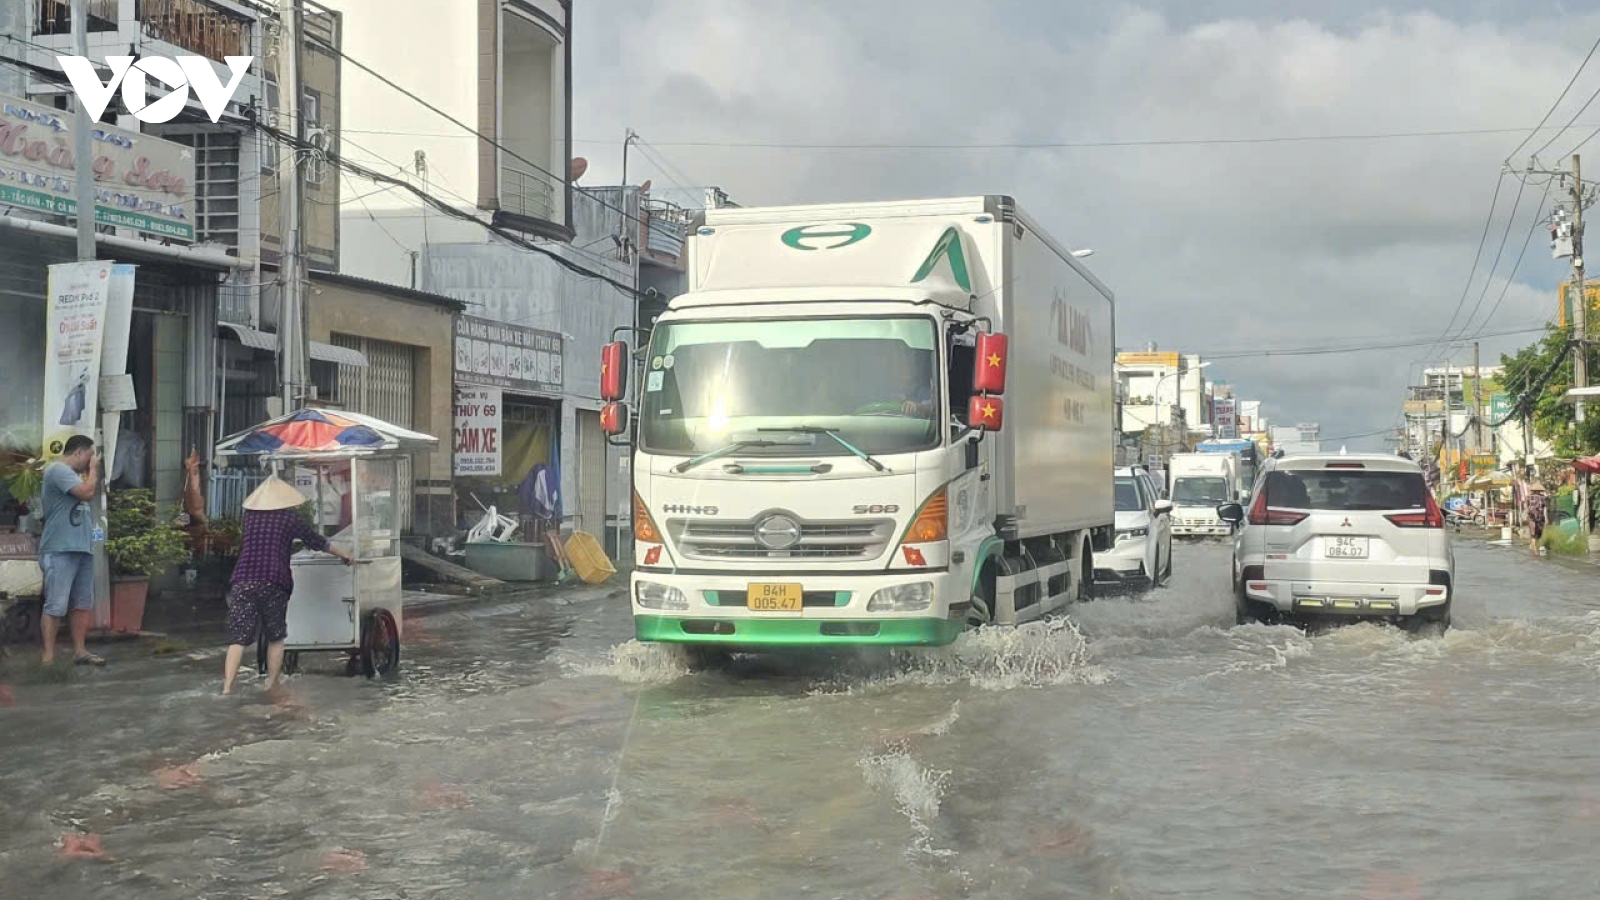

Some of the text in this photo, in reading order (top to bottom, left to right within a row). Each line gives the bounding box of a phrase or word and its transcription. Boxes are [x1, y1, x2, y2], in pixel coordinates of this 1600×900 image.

[484, 404, 496, 417] 69
[481, 428, 497, 453] XE
[1336, 537, 1356, 547] 94C
[763, 584, 786, 597] 84H
[754, 598, 796, 610] 005.47
